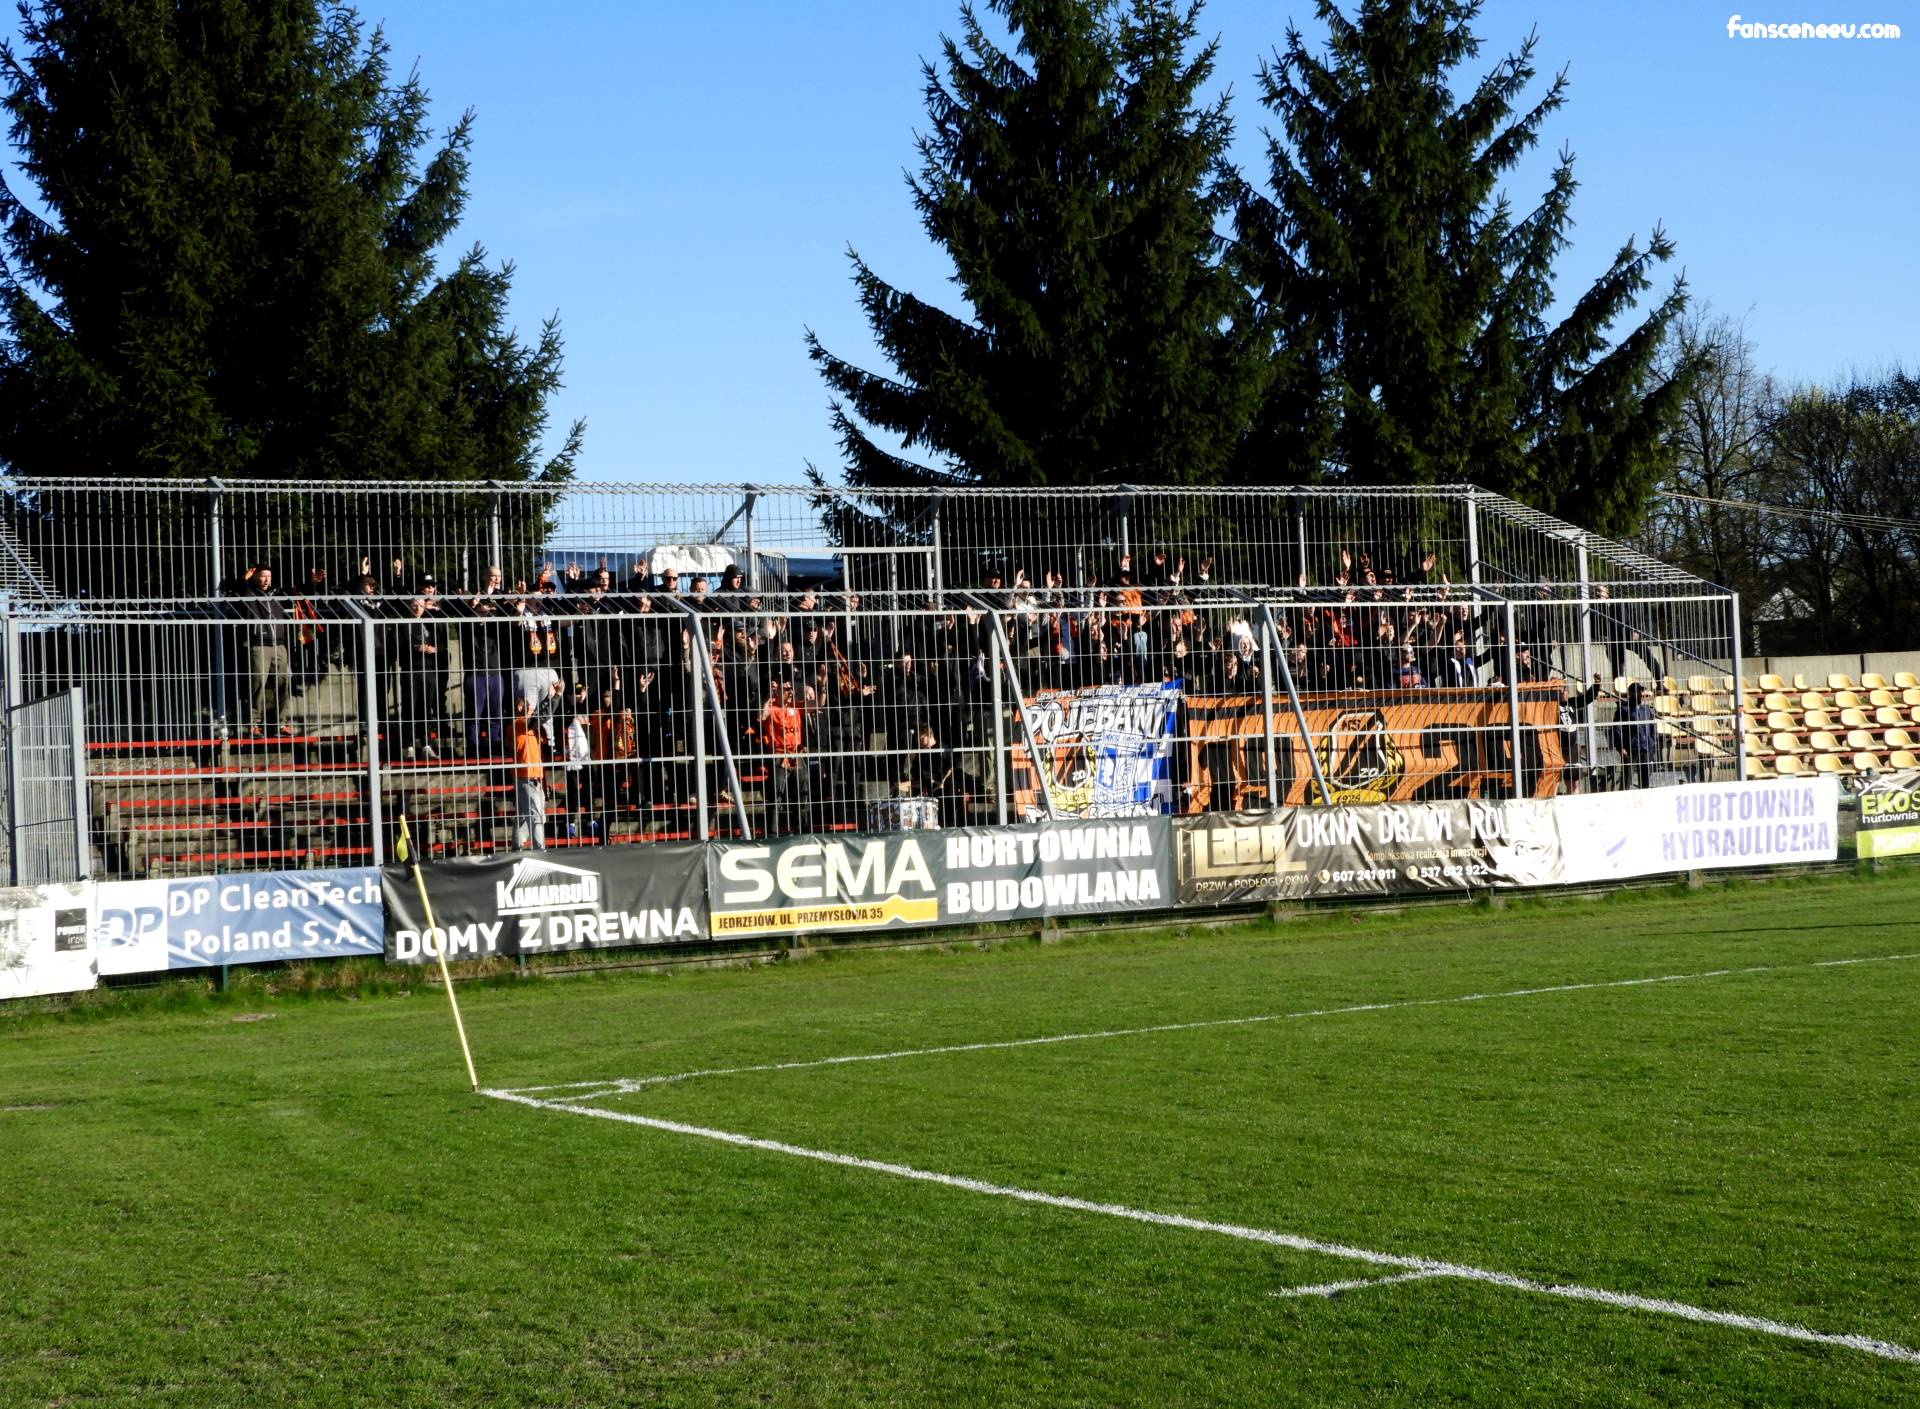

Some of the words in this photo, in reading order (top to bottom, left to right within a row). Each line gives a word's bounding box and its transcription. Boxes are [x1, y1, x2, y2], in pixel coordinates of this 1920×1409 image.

[1677, 788, 1815, 824] HURTOWNIA
[1862, 811, 1918, 823] hurtownia
[1379, 809, 1452, 843] DRZWI
[1662, 822, 1830, 861] HYDRAULICZNA
[946, 826, 1152, 869] HURTOWNIA
[720, 839, 936, 903] SEMA
[1196, 881, 1226, 892] DRZWI
[1332, 870, 1354, 882] 607
[169, 890, 210, 917] DP
[220, 878, 382, 911] CleanTech
[946, 869, 1161, 915] BUDOWLANA
[396, 921, 504, 960] DOMY
[519, 918, 542, 948] Z
[550, 907, 699, 945] DREWNA
[780, 911, 795, 925] UL.
[870, 907, 883, 919] 35
[184, 925, 291, 954] Poland
